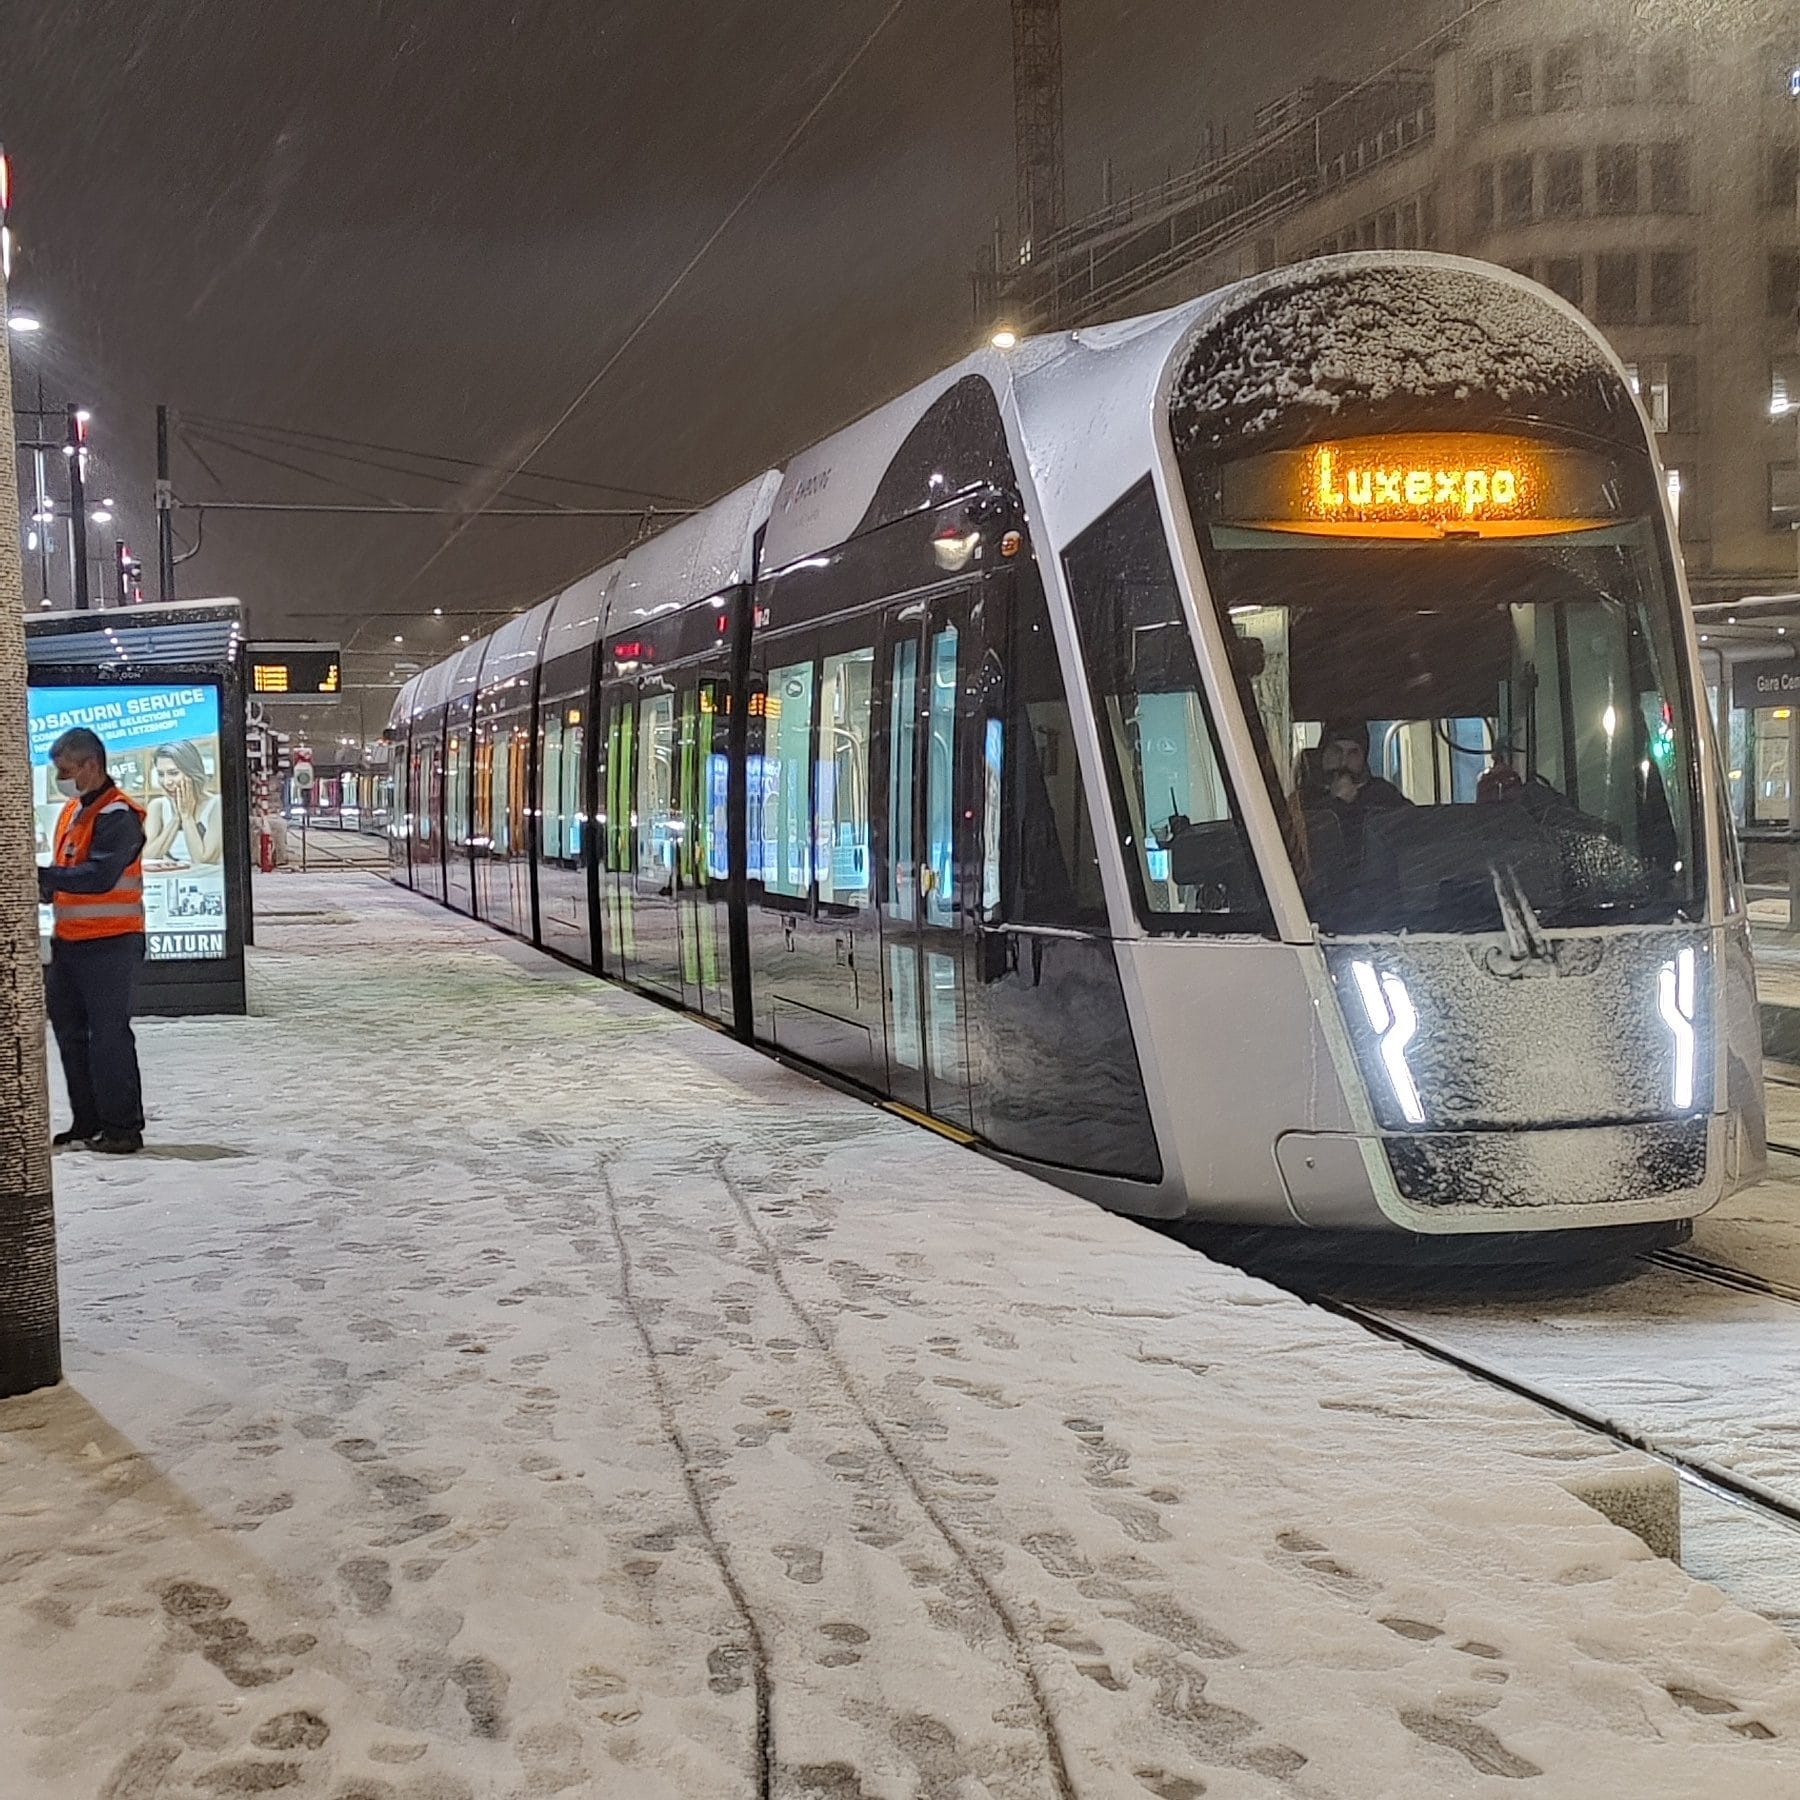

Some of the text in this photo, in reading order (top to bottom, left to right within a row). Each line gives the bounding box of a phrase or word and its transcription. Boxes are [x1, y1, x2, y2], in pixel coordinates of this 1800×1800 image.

[1319, 450, 1518, 514] Luxexpo
[127, 688, 205, 716] SERVICE
[97, 707, 186, 731] UNE SELECTION DE
[105, 729, 127, 741] SUR
[149, 934, 223, 953] SATURN
